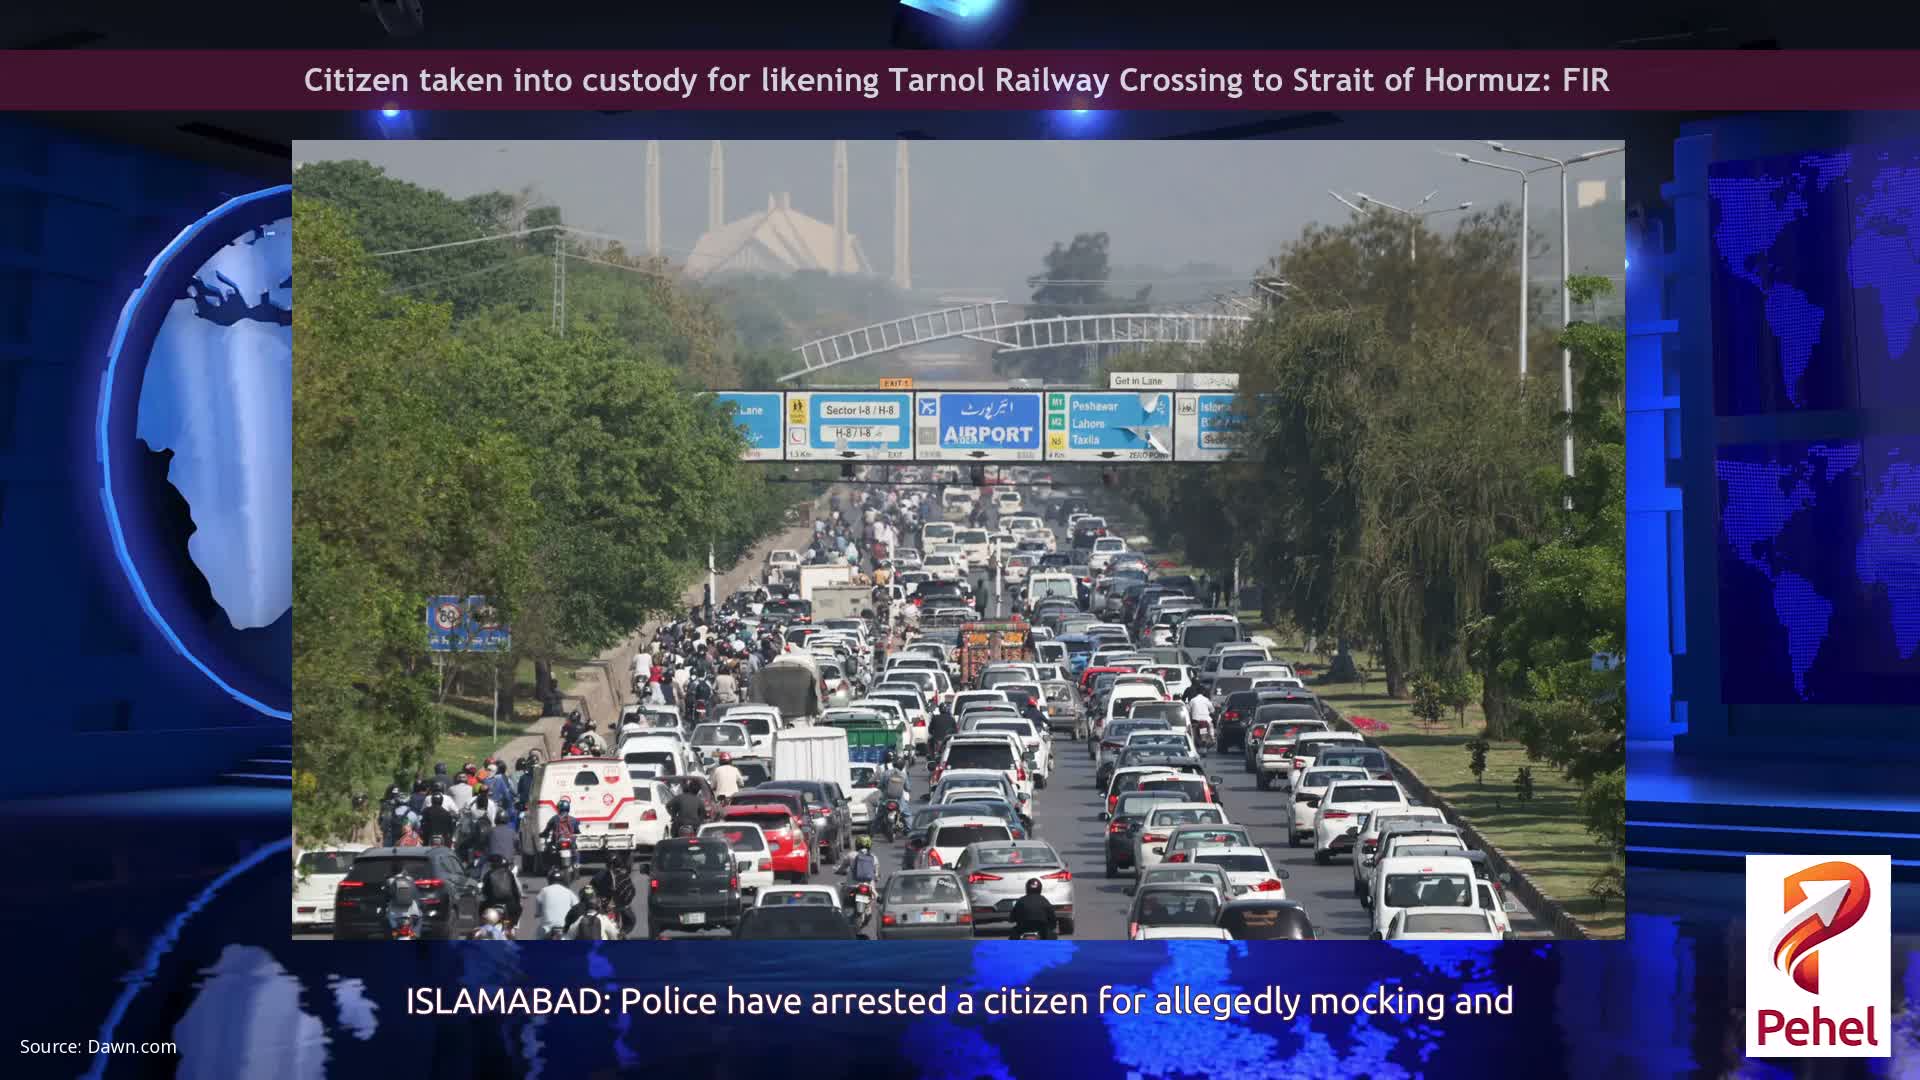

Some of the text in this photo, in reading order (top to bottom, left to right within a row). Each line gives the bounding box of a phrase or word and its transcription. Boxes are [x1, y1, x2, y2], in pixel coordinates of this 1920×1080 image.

[1115, 376, 1130, 386] Get
[1142, 376, 1162, 386] Lane
[740, 406, 763, 416] Lane
[826, 406, 856, 416] Sector
[879, 406, 894, 415] H-8
[1072, 401, 1119, 412] Peshawar
[1072, 418, 1105, 429] Lahore
[836, 428, 851, 438] H-8
[944, 426, 1033, 444] AIRPORT
[1072, 434, 1100, 445] Taxila
